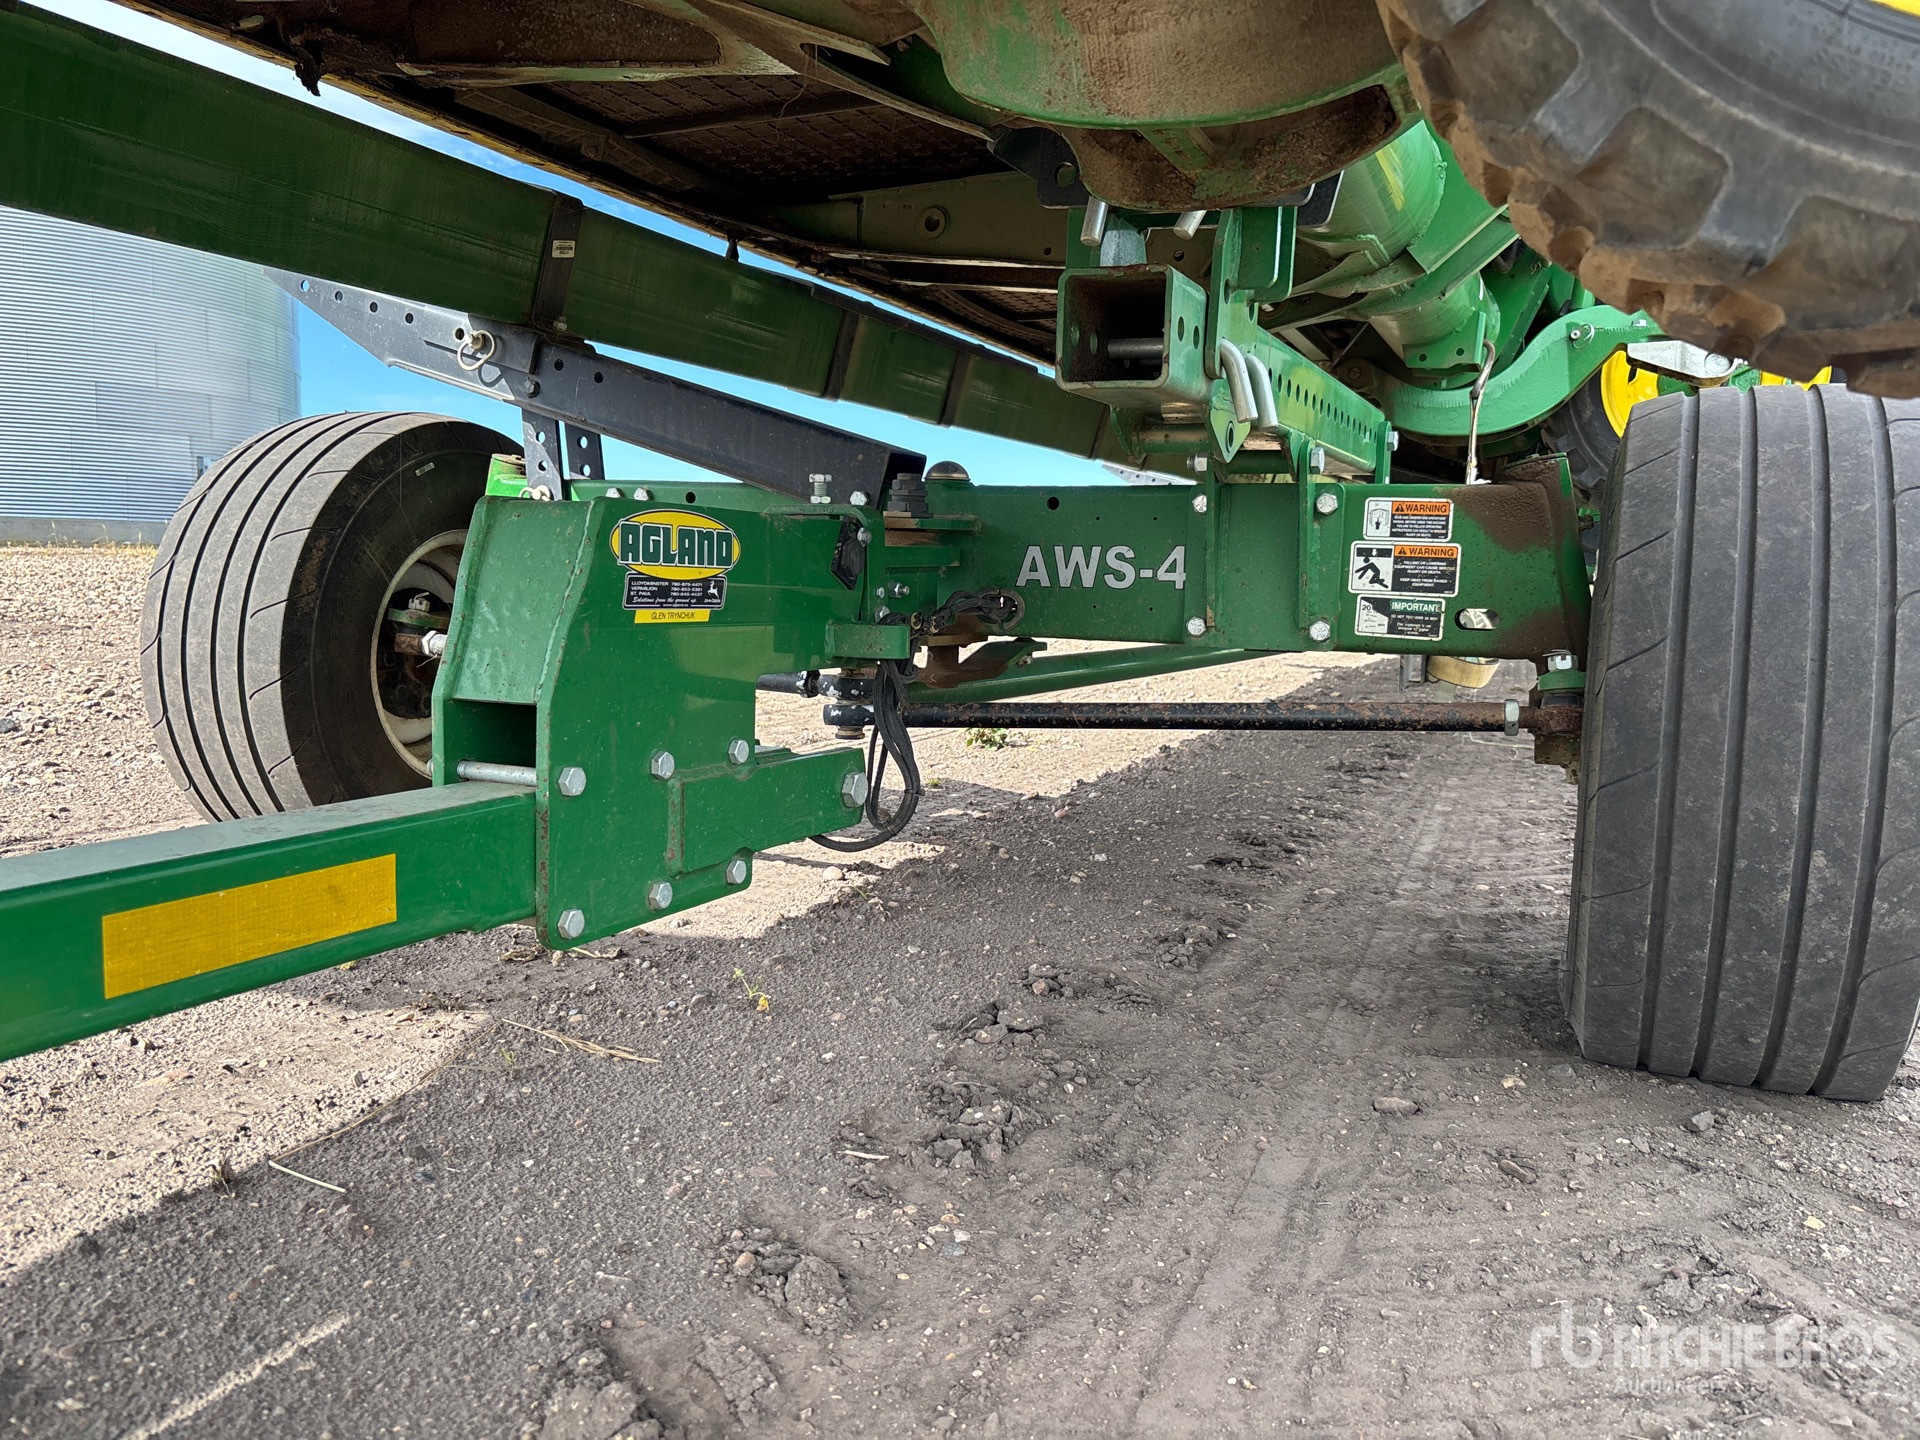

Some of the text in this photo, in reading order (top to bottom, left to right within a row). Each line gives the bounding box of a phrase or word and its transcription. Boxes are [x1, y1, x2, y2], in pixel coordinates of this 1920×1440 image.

[1406, 504, 1447, 513] WARNING
[619, 522, 734, 568] AGLAND
[1409, 548, 1454, 557] WARNING
[1015, 545, 1186, 589] AWS-4
[1392, 602, 1440, 612] IMPORTANT
[651, 611, 667, 620] GLEN
